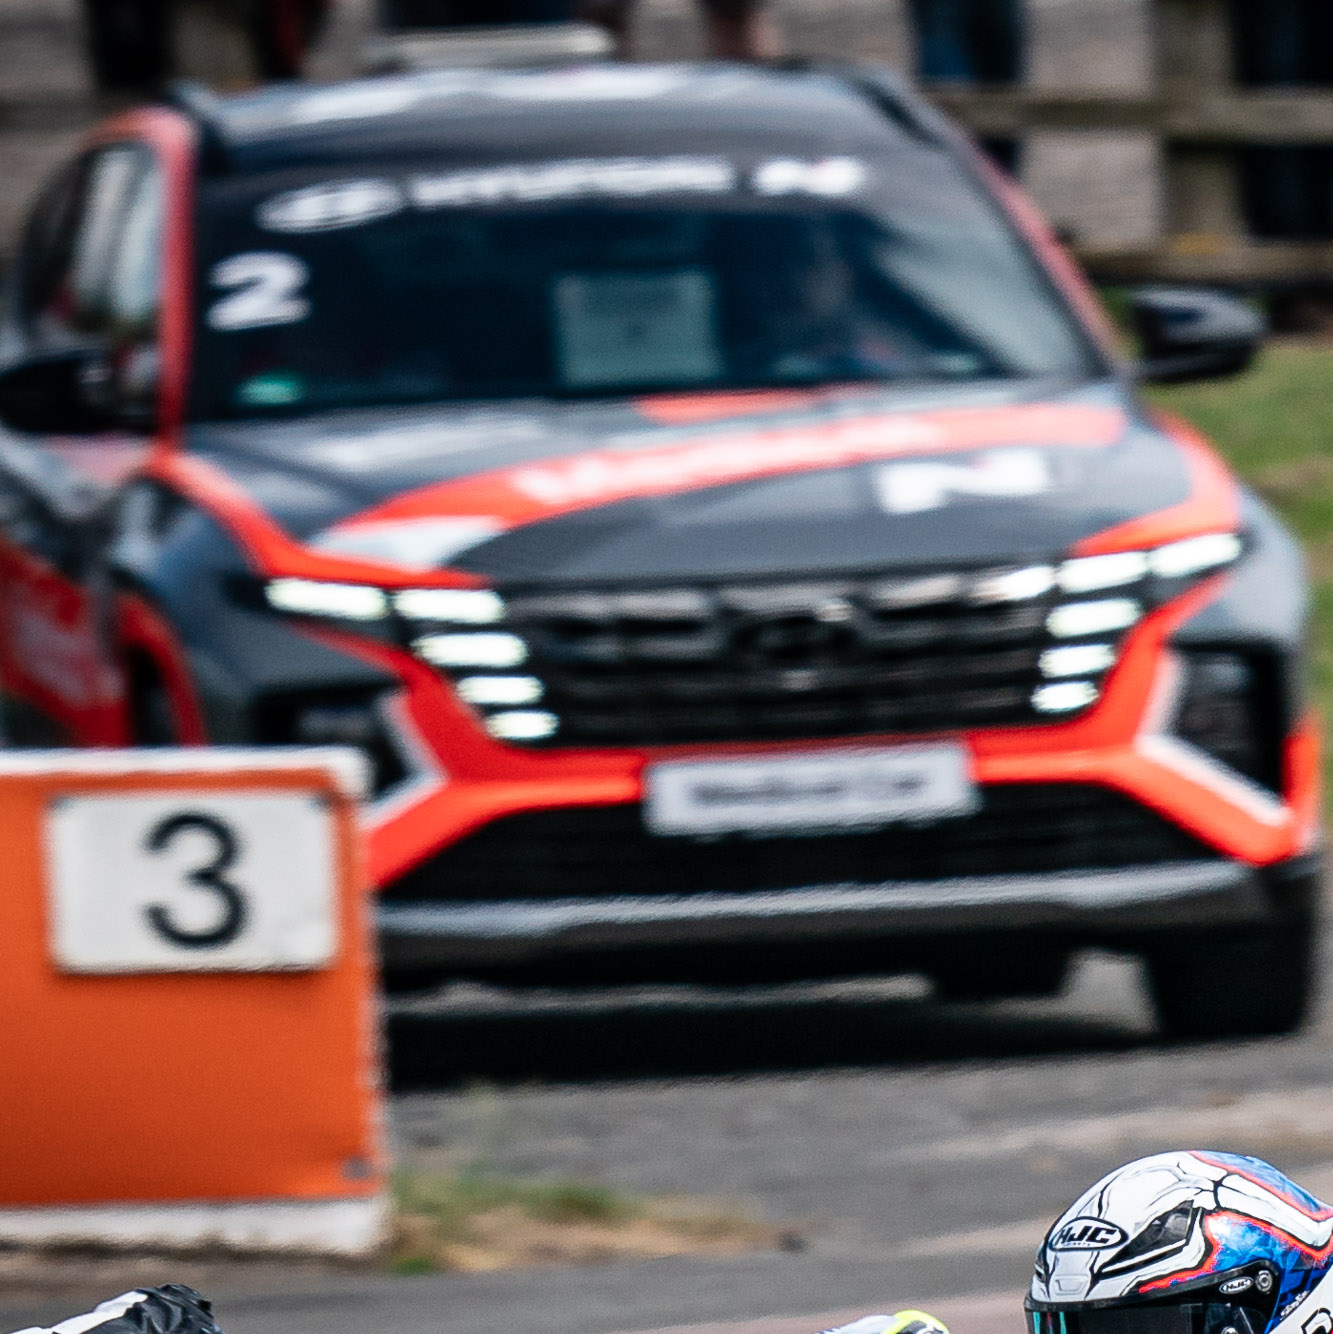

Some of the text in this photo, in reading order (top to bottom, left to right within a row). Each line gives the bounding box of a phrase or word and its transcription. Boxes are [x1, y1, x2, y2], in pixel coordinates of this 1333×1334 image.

[209, 253, 310, 329] 2
[145, 811, 250, 950] 3
[1054, 1225, 1119, 1246] HJC
[1225, 1278, 1250, 1293] HJC
